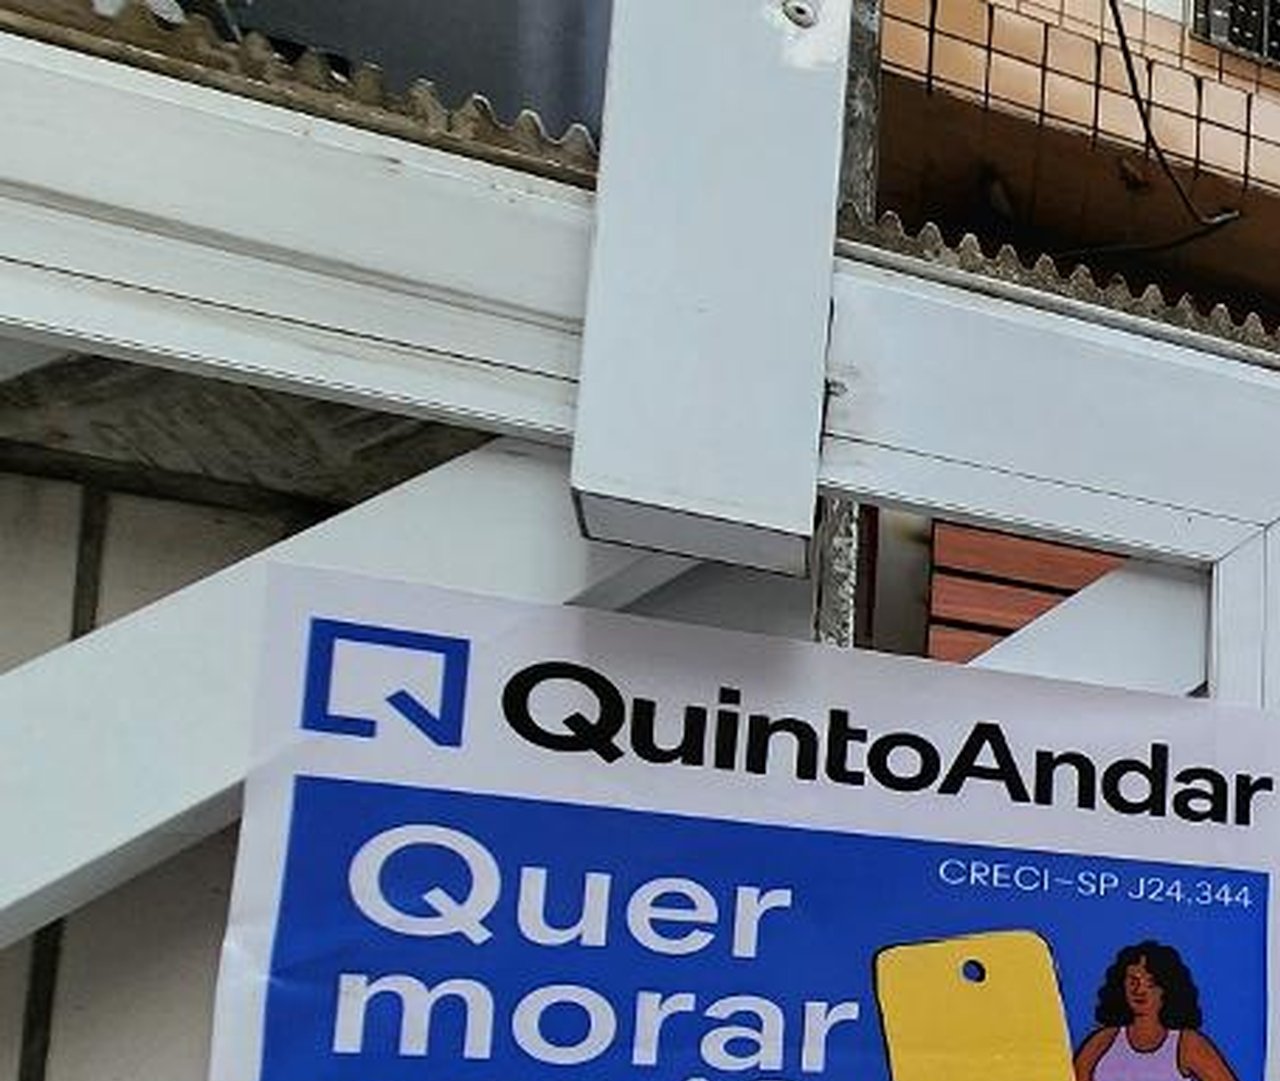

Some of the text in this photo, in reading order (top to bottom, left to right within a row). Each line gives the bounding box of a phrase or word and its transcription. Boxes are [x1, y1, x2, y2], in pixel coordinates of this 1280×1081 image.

[500, 660, 1274, 827] QuintoAndar
[347, 823, 793, 959] Quer
[1127, 876, 1253, 909] J24.344
[332, 972, 860, 1074] morar
